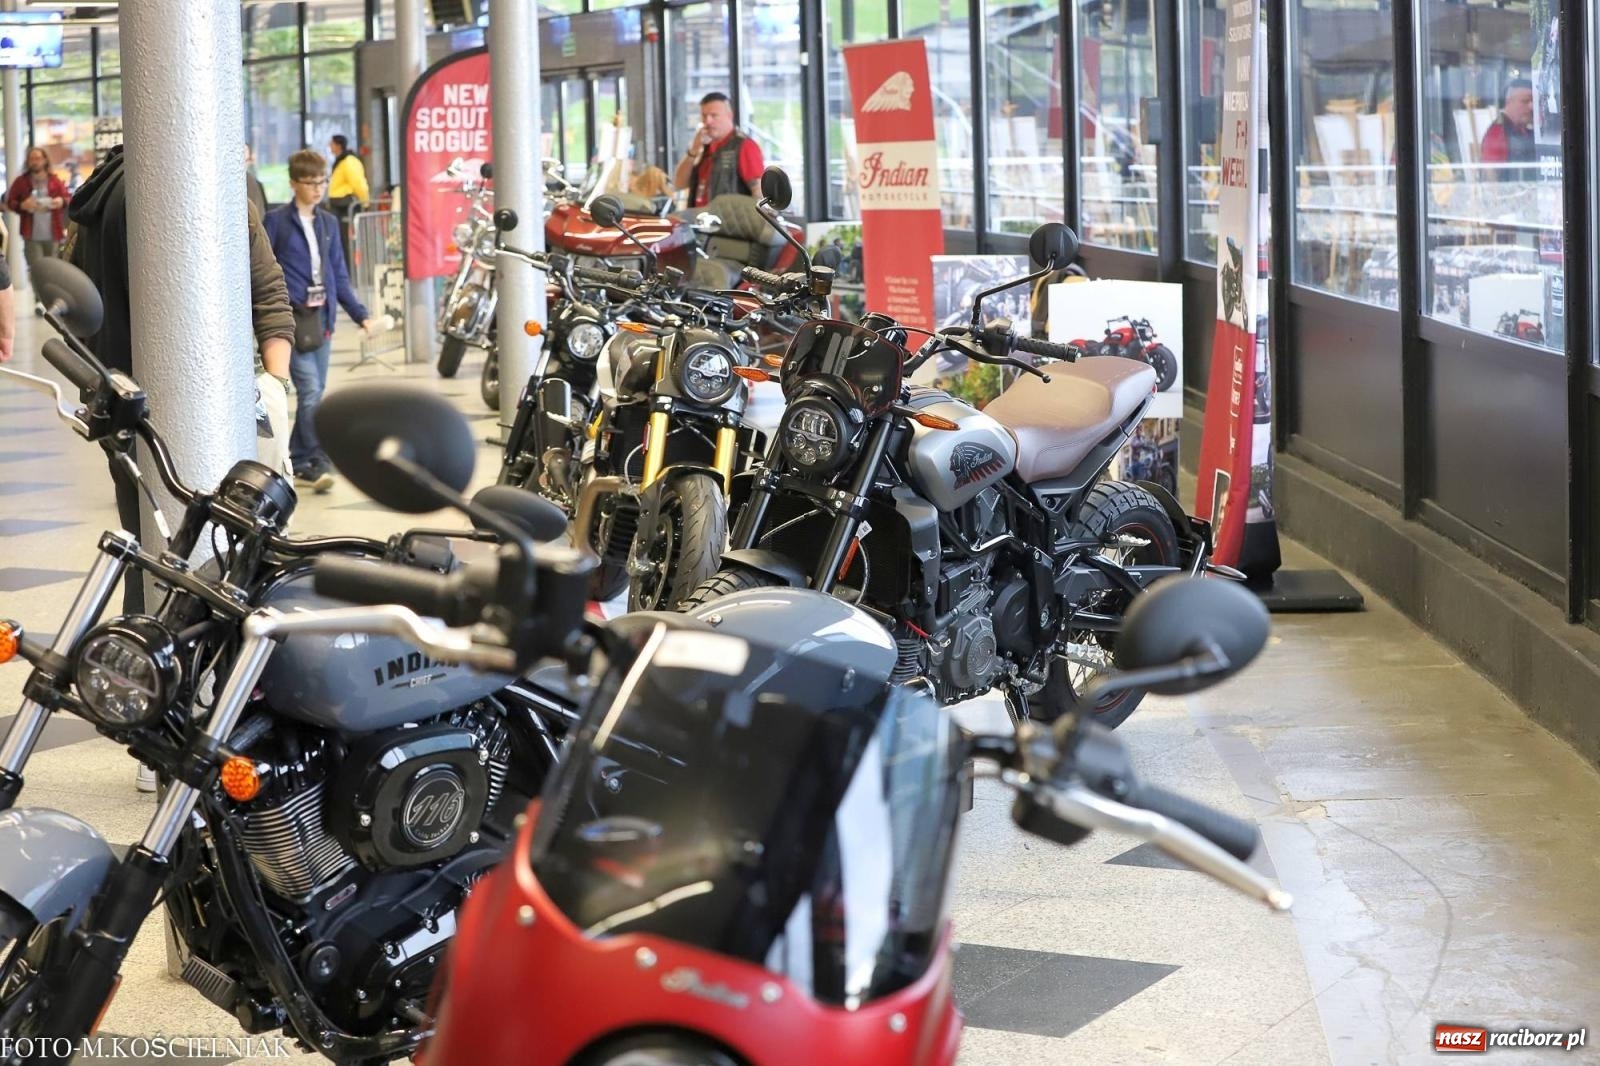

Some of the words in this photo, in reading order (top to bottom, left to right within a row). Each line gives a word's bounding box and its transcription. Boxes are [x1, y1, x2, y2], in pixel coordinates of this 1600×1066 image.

[443, 83, 489, 106] NEW
[415, 106, 489, 129] SCOUT
[414, 129, 489, 153] ROGUE
[859, 151, 929, 189] Indian
[970, 451, 993, 469] Indian
[404, 788, 465, 828] 116
